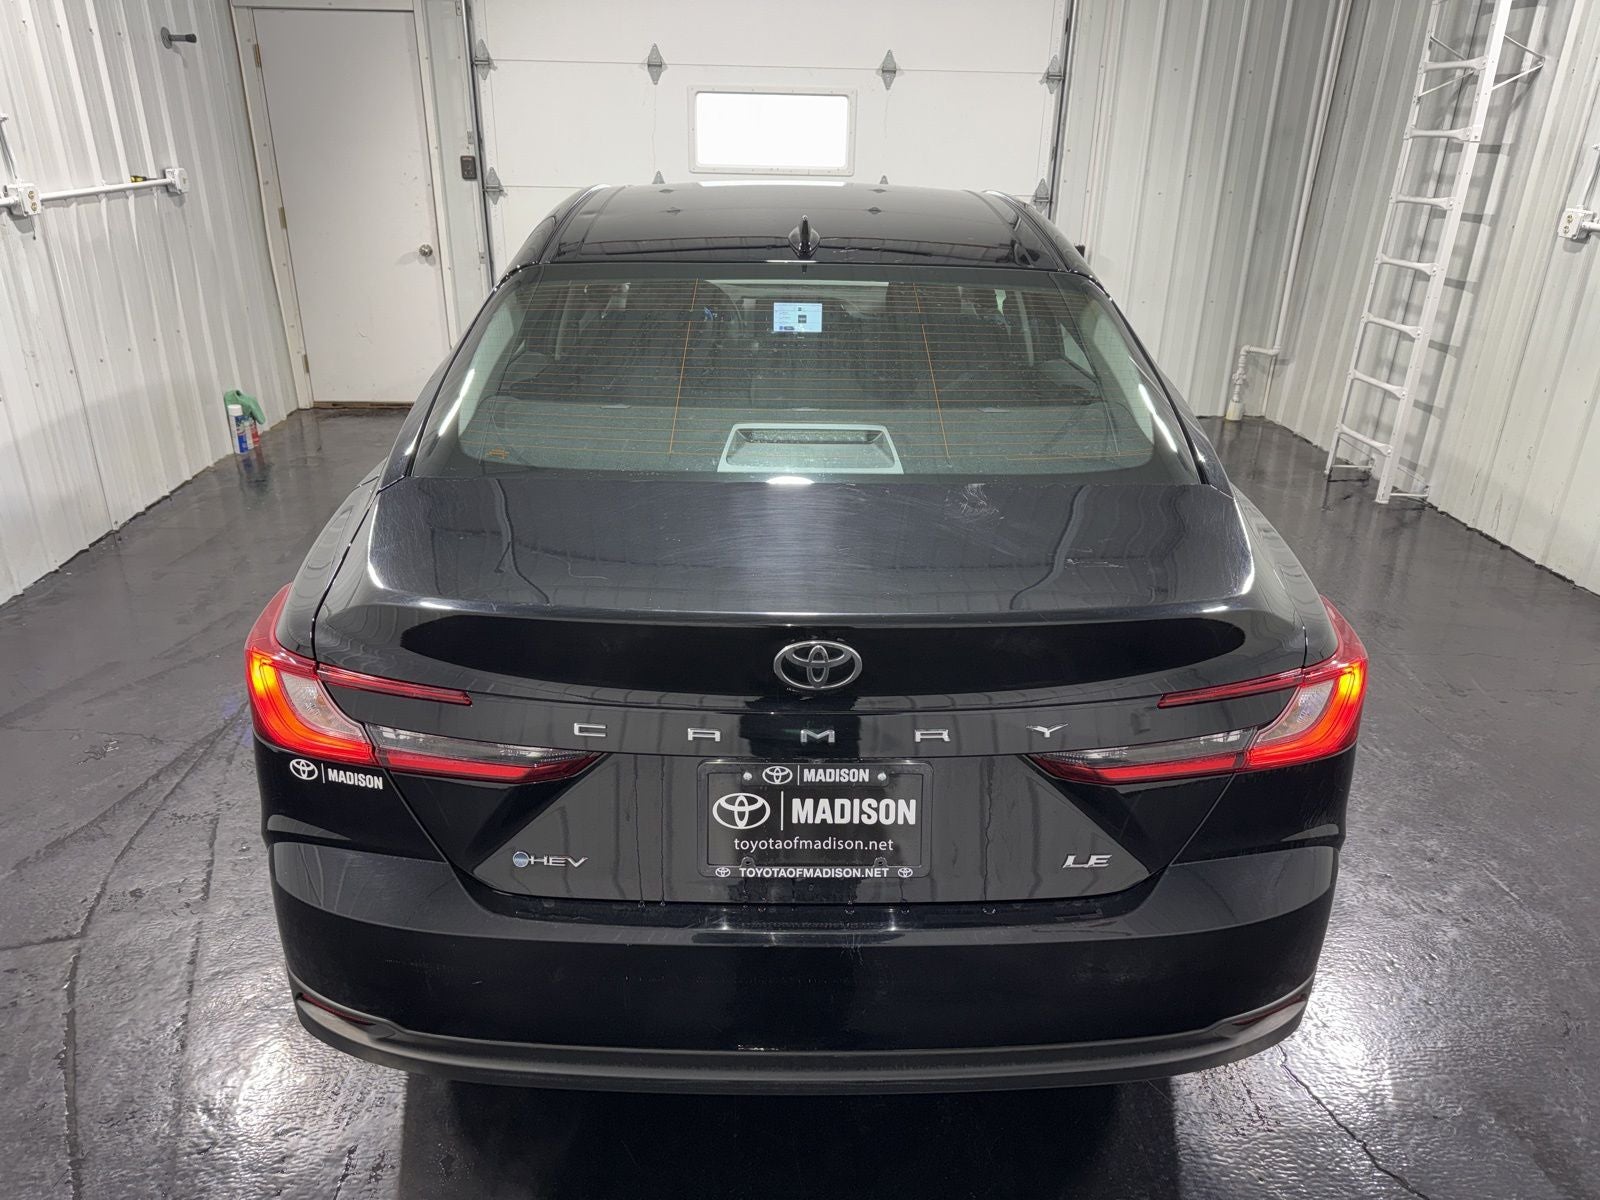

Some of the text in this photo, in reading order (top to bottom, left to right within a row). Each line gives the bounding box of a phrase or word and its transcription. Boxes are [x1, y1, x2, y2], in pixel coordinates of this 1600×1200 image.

[573, 722, 1069, 743] CAMRY
[327, 768, 384, 790] MADISON
[803, 768, 870, 783] MADISON
[791, 798, 916, 825] MADISON
[733, 836, 894, 854] toyotaofmadison.net
[1062, 854, 1113, 869] LE
[738, 867, 890, 878] TOYOTAOFMADISON.NET
